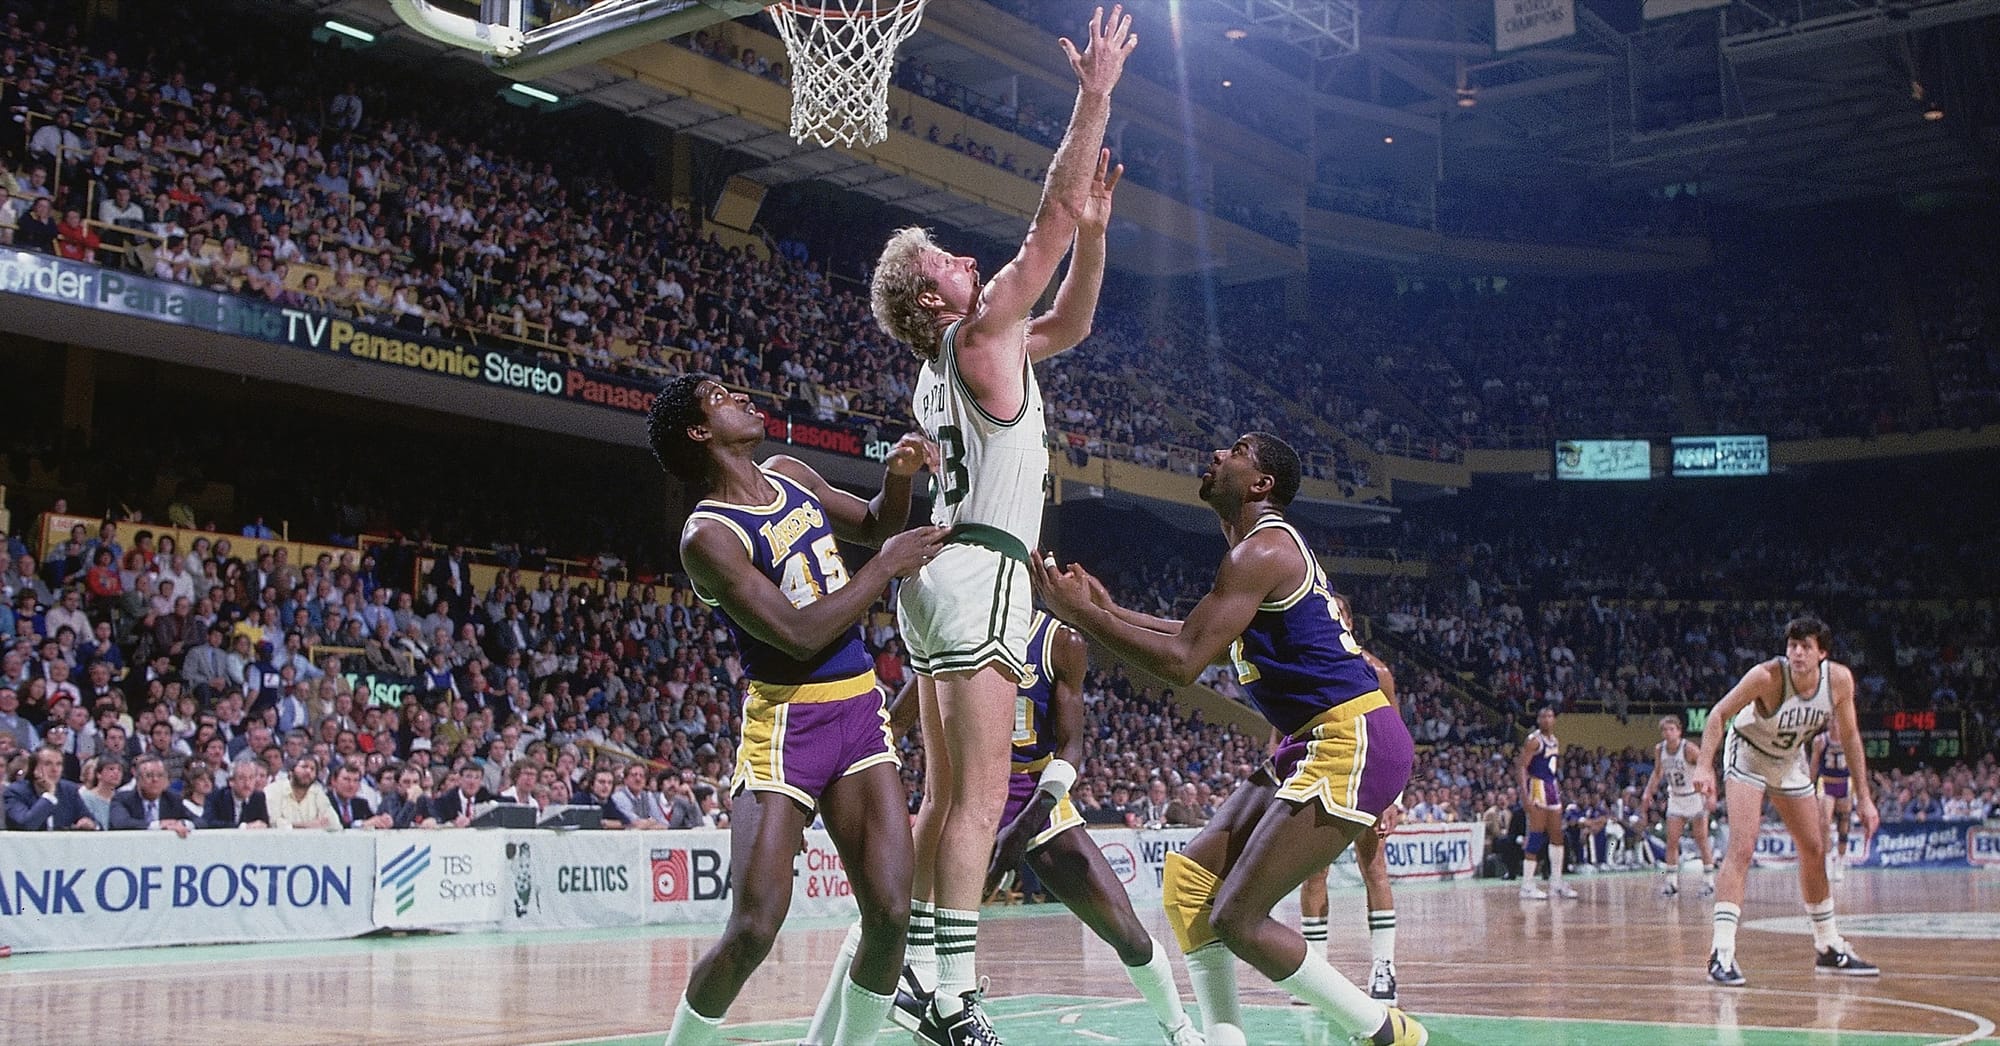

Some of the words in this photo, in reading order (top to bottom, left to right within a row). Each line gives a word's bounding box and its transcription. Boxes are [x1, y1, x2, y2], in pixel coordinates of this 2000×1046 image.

[282, 308, 328, 347] TV
[330, 319, 480, 378] Panasonic
[484, 352, 562, 394] Stereo
[759, 500, 824, 568] LAKERS
[780, 533, 850, 610] 45
[440, 855, 472, 875] TBS
[1421, 840, 1467, 864] LIGHT
[95, 866, 162, 912] OF
[172, 863, 351, 908] BOSTON
[440, 879, 497, 902] Sports
[558, 864, 628, 893] CELTICS
[807, 876, 819, 898] &
